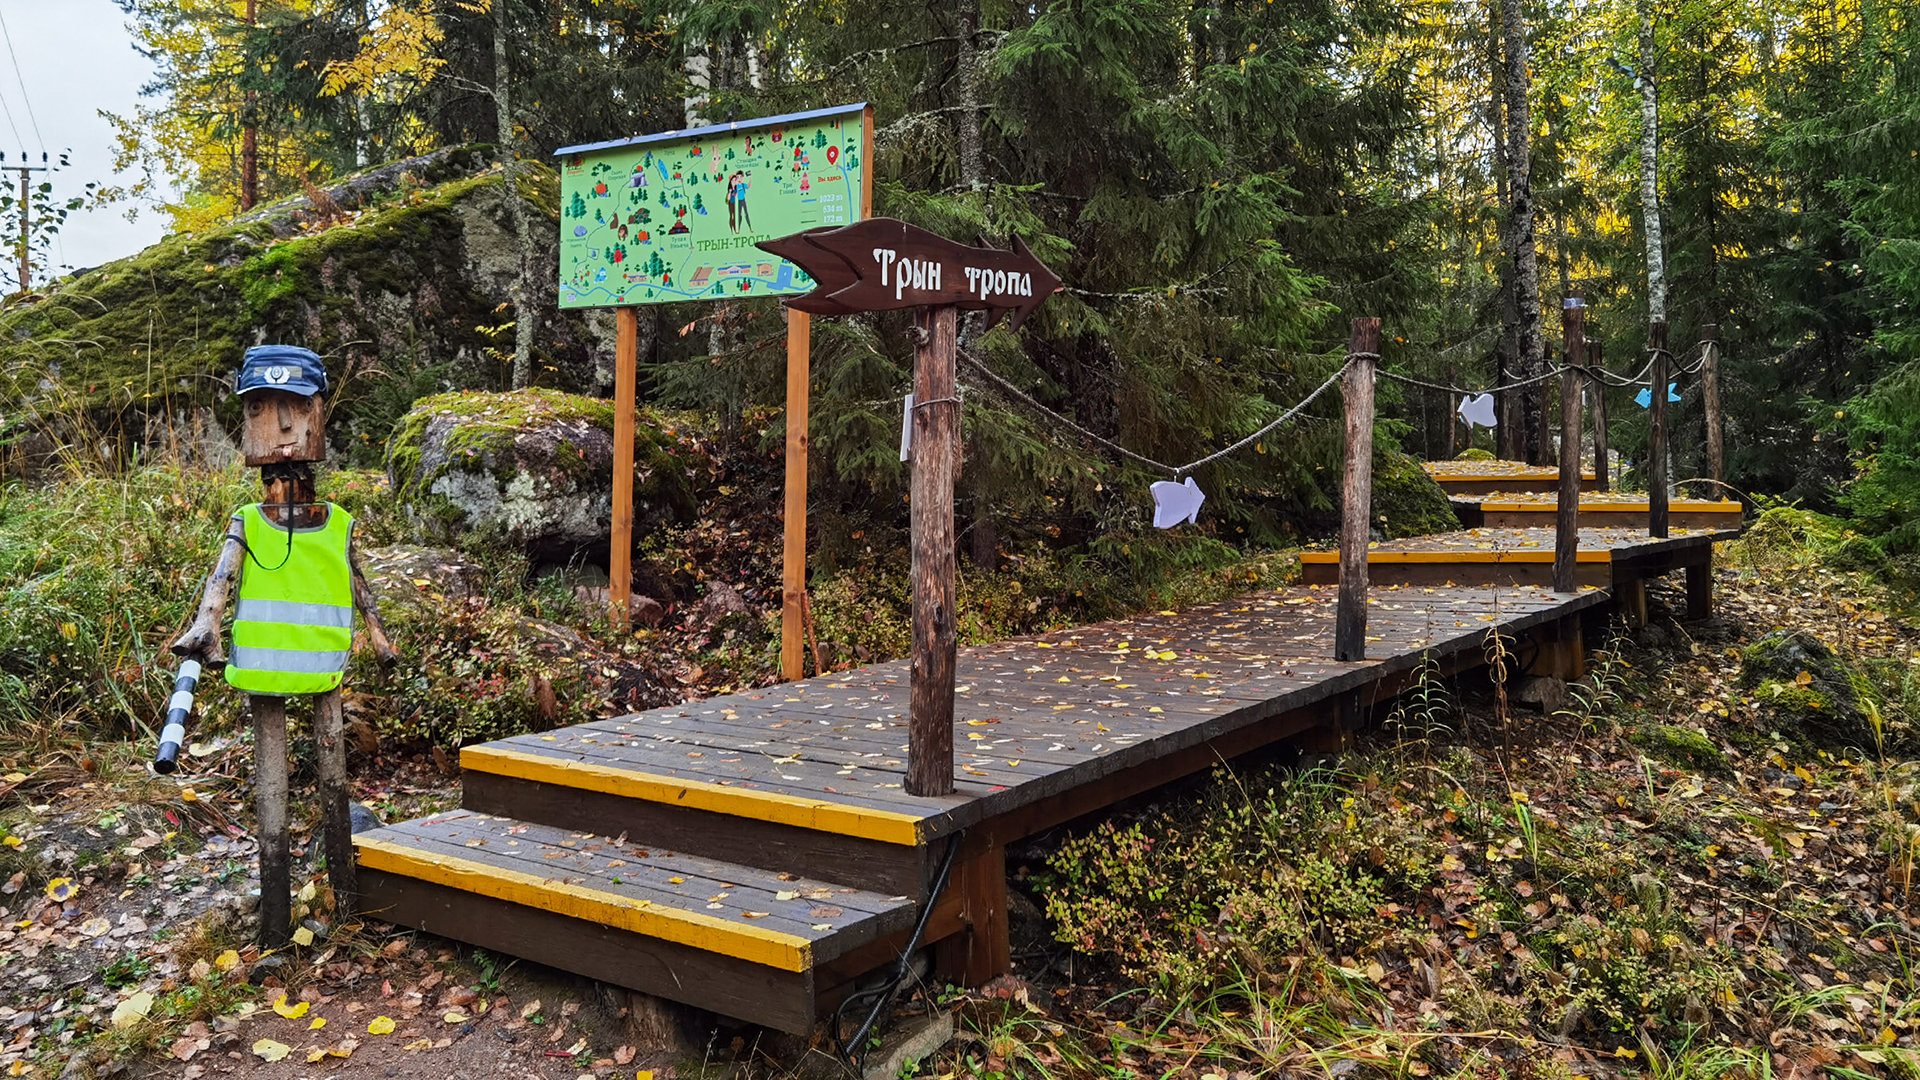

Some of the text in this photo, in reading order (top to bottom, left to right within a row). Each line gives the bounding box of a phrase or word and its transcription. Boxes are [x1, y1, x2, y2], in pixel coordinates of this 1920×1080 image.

[823, 215, 835, 224] 172
[872, 248, 1033, 301] Трын тропа
